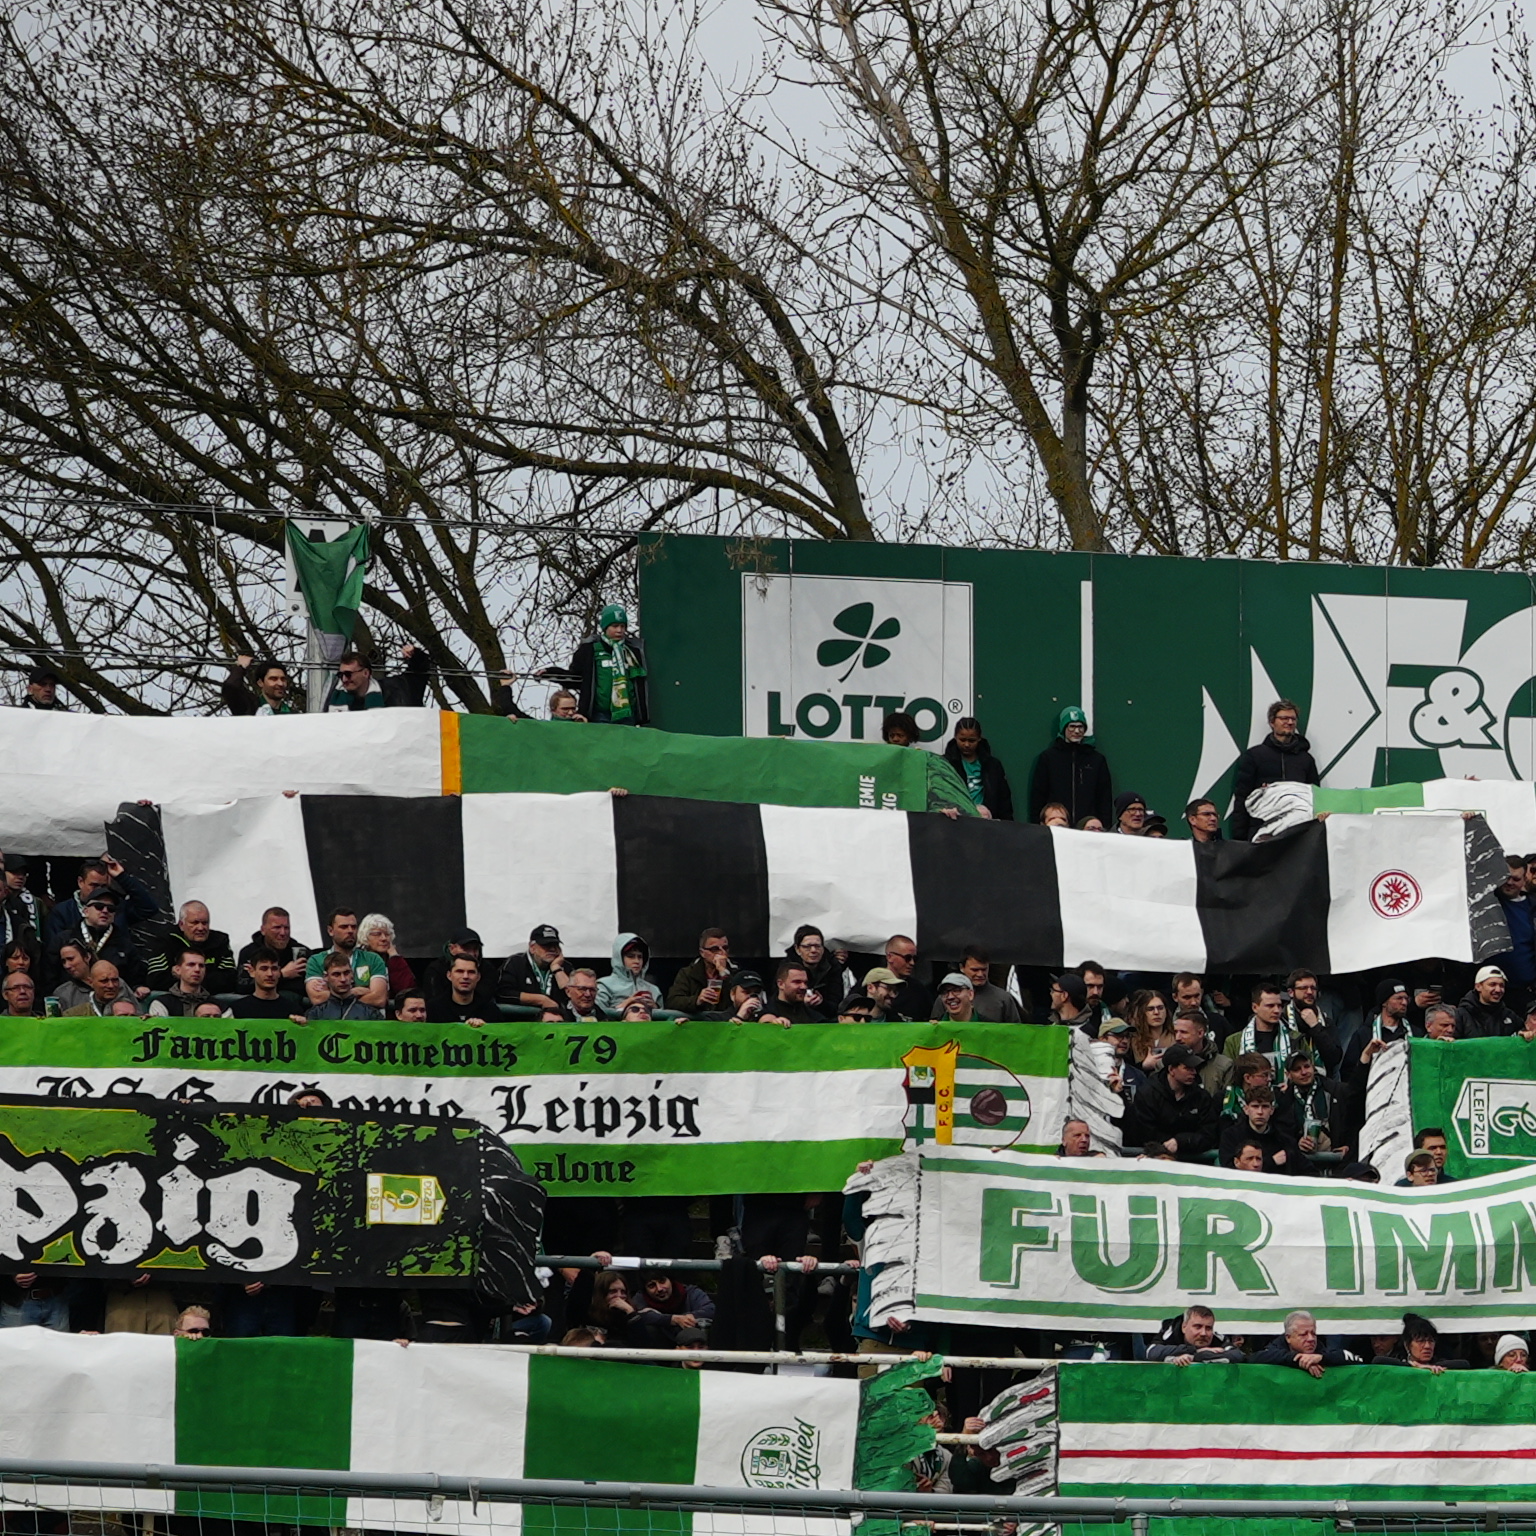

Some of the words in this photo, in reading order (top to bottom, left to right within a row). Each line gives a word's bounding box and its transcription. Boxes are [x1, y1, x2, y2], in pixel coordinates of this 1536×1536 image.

[132, 1026, 297, 1064] Fanclub
[318, 1030, 519, 1073] Connewitz
[491, 1080, 701, 1140] Leipzig
[1473, 1088, 1485, 1149] LEIPZIG
[535, 1151, 635, 1184] alone
[978, 1186, 1278, 1297] FÜR
[786, 1417, 820, 1489] itglied
